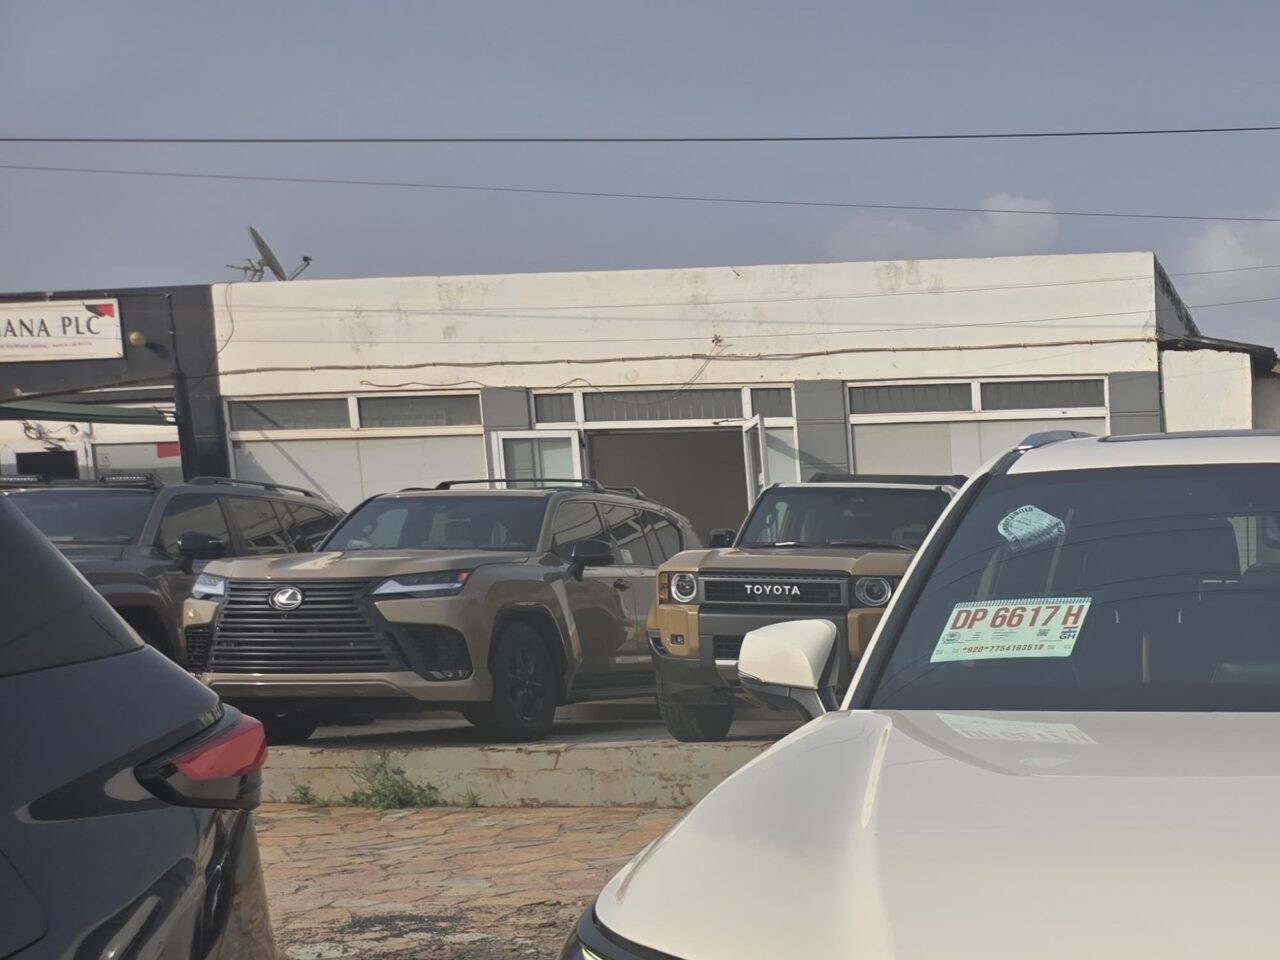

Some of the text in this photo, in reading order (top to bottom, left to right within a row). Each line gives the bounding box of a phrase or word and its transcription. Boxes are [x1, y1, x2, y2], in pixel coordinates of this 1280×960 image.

[0, 315, 101, 337] ANA PLC
[744, 584, 801, 595] TOYOTA
[950, 604, 1085, 630] DP 6617 H
